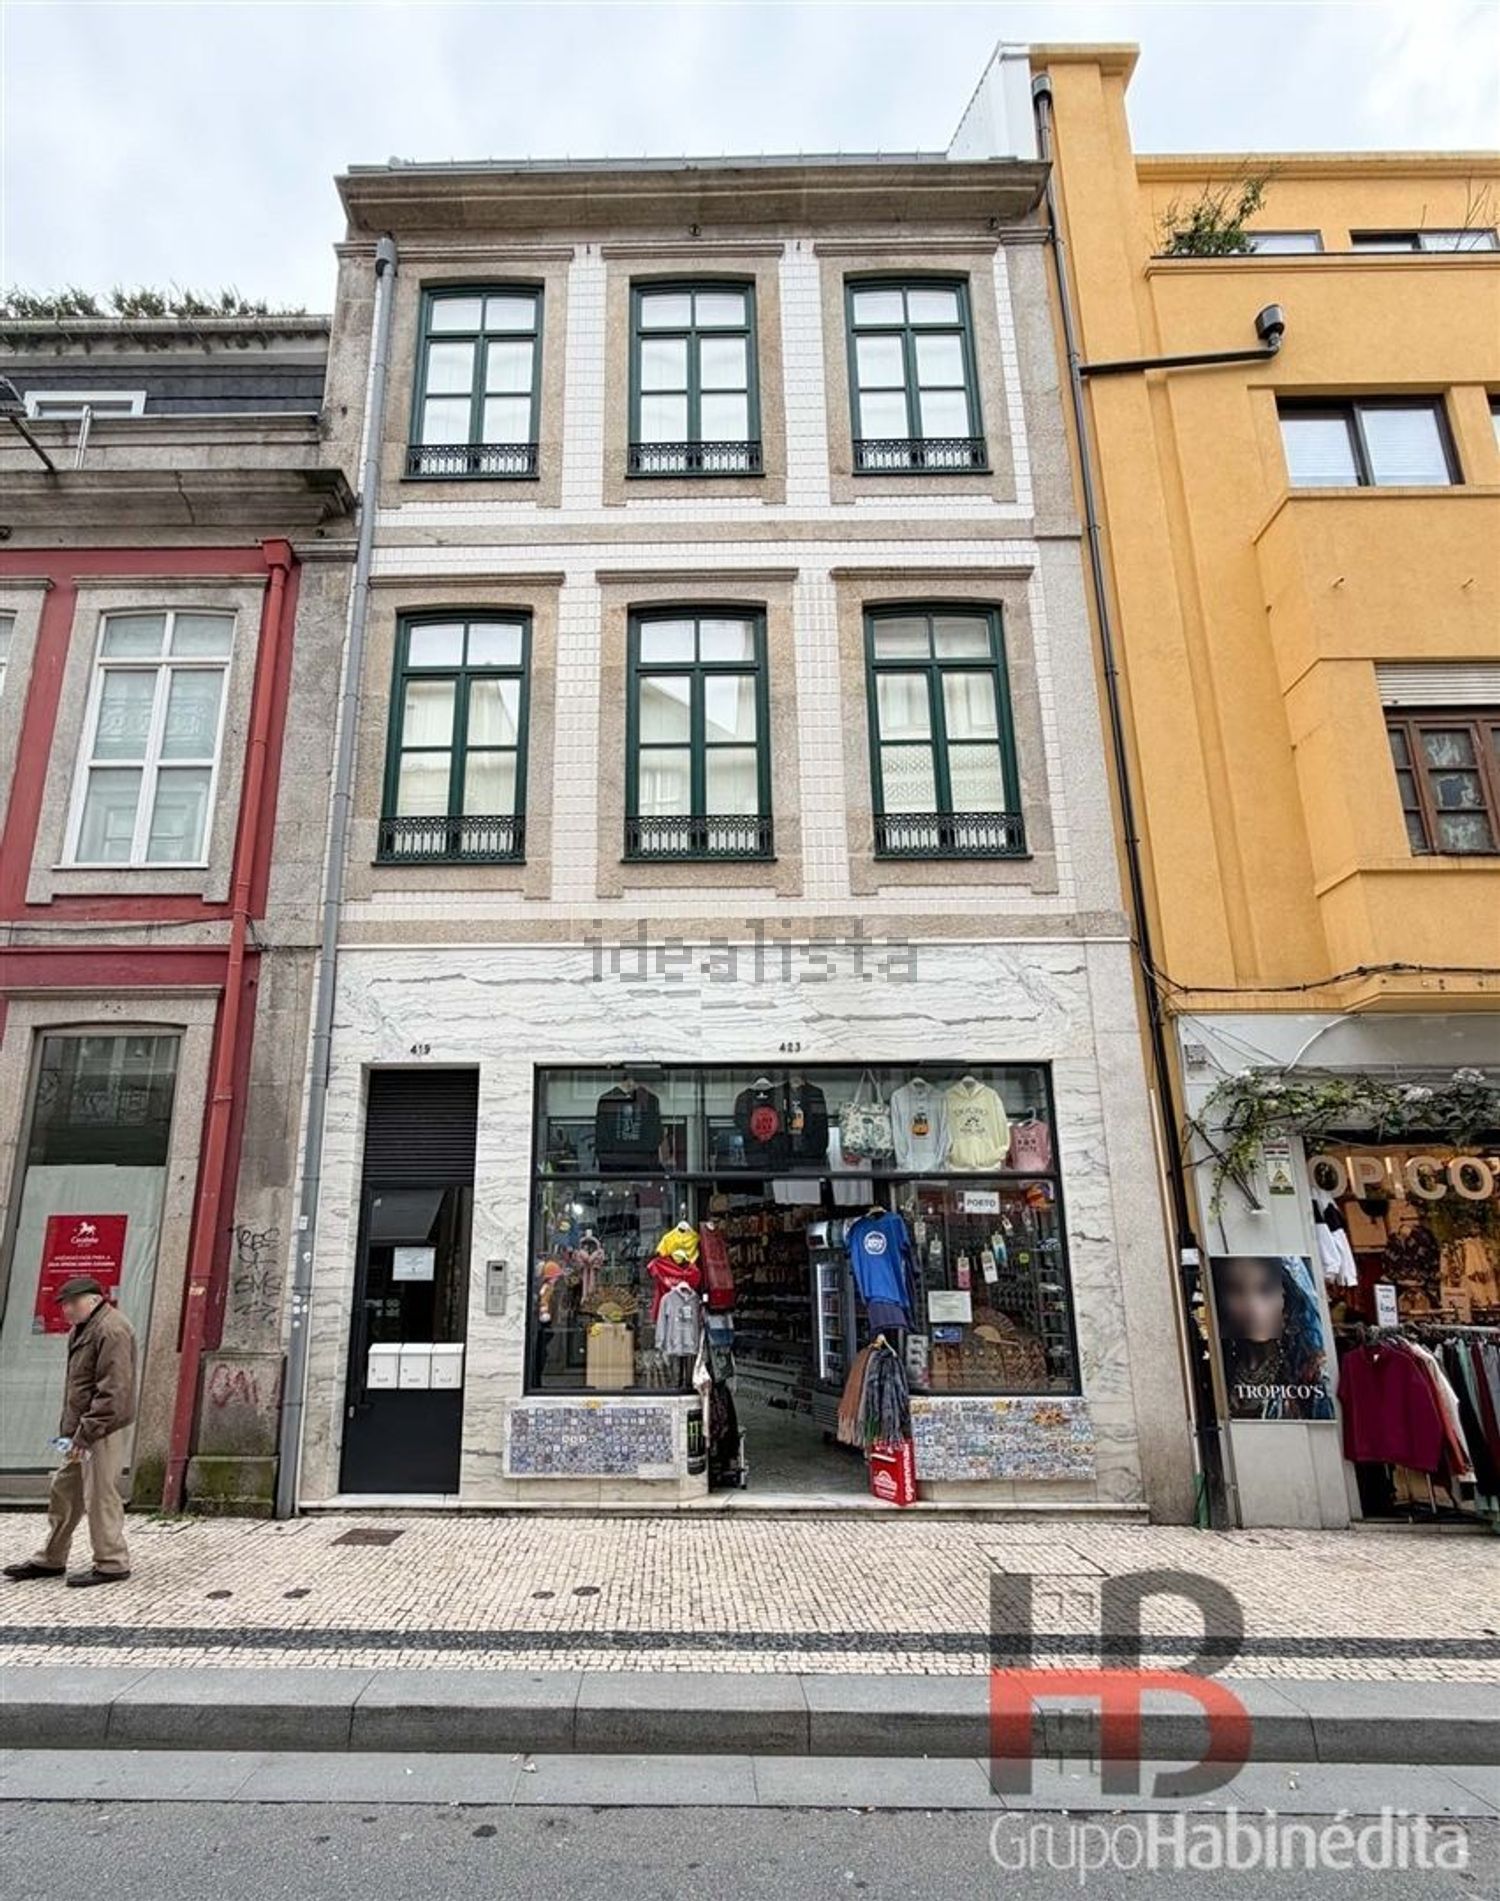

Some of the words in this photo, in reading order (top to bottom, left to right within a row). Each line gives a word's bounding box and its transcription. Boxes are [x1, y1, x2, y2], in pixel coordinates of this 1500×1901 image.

[410, 1044, 431, 1055] 419
[779, 1042, 801, 1053] 423
[1234, 1383, 1325, 1399] TROPICO'S
